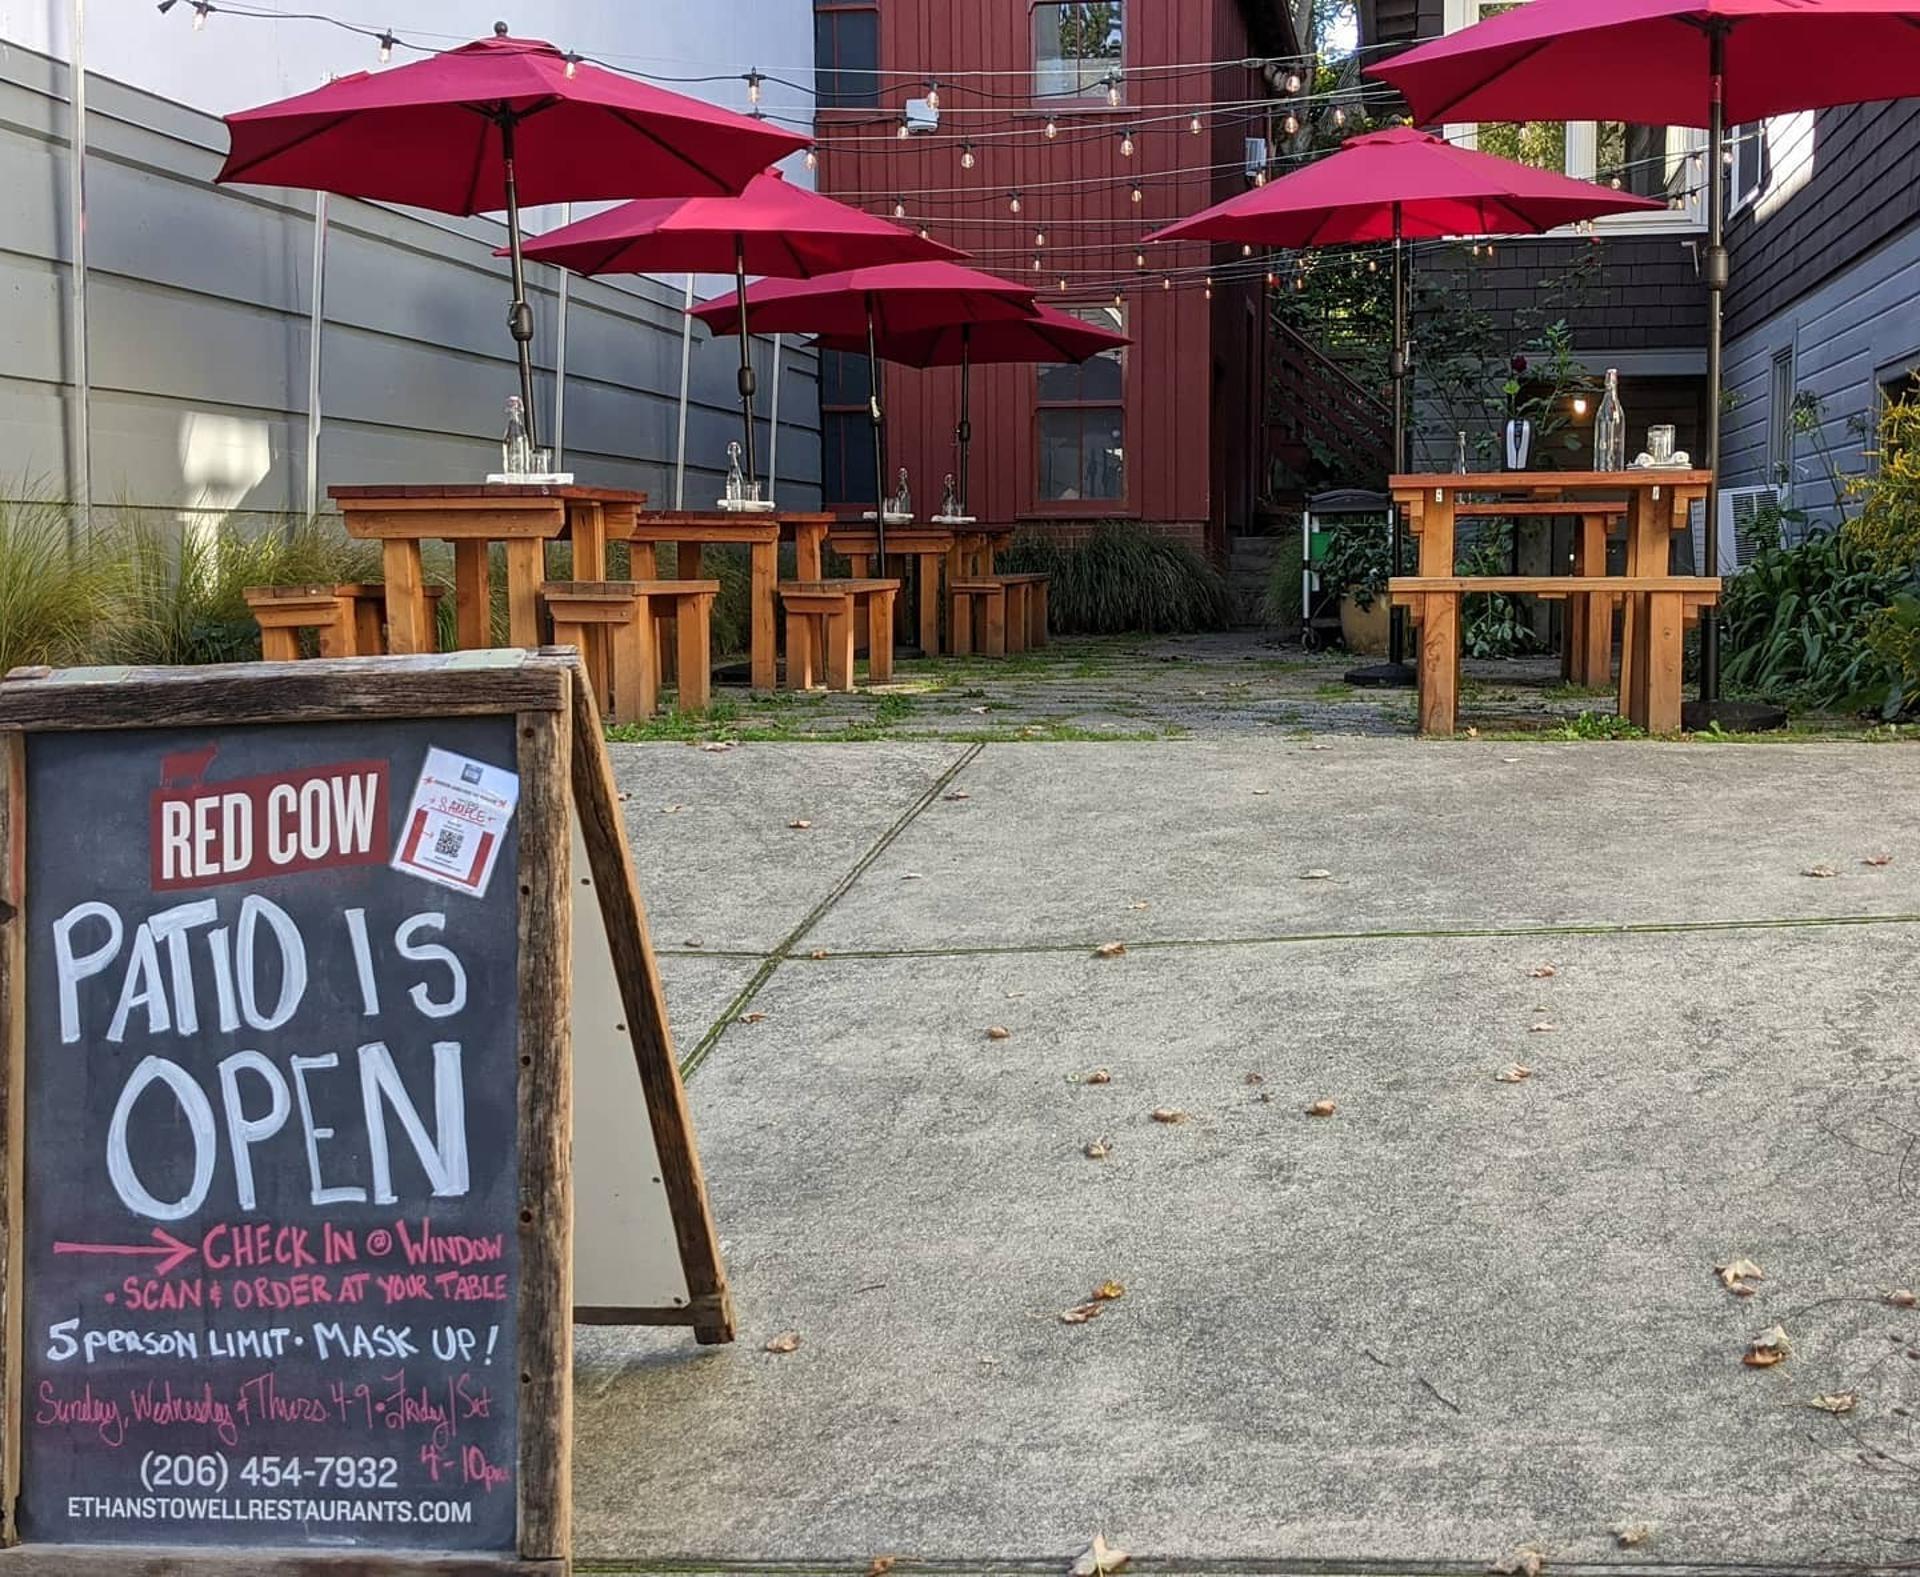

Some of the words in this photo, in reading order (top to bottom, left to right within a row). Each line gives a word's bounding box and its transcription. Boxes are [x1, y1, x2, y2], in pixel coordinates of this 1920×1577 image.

[161, 793, 254, 880] RED
[267, 772, 379, 865] COW
[53, 894, 308, 1045] PATIO
[344, 907, 468, 1019] IS
[106, 1041, 470, 1220] OPEN
[203, 1222, 317, 1269] CHECK
[323, 1222, 357, 1265] IN
[366, 1228, 393, 1256] @
[395, 1216, 503, 1266] WINDOW
[123, 1275, 203, 1312] SCAN
[233, 1273, 333, 1309] ORDER
[338, 1272, 371, 1303] AT
[376, 1273, 434, 1304] YOUR
[435, 1270, 508, 1301] TABLE
[47, 1317, 80, 1362] 5
[208, 1328, 291, 1359] LIMIT
[312, 1322, 419, 1360] MASK
[432, 1325, 500, 1366] UP!
[140, 1450, 229, 1493] (206)
[240, 1456, 399, 1489] 454-7932
[67, 1496, 472, 1524] ETHANSTOWELLRESTAURANTS.COM
